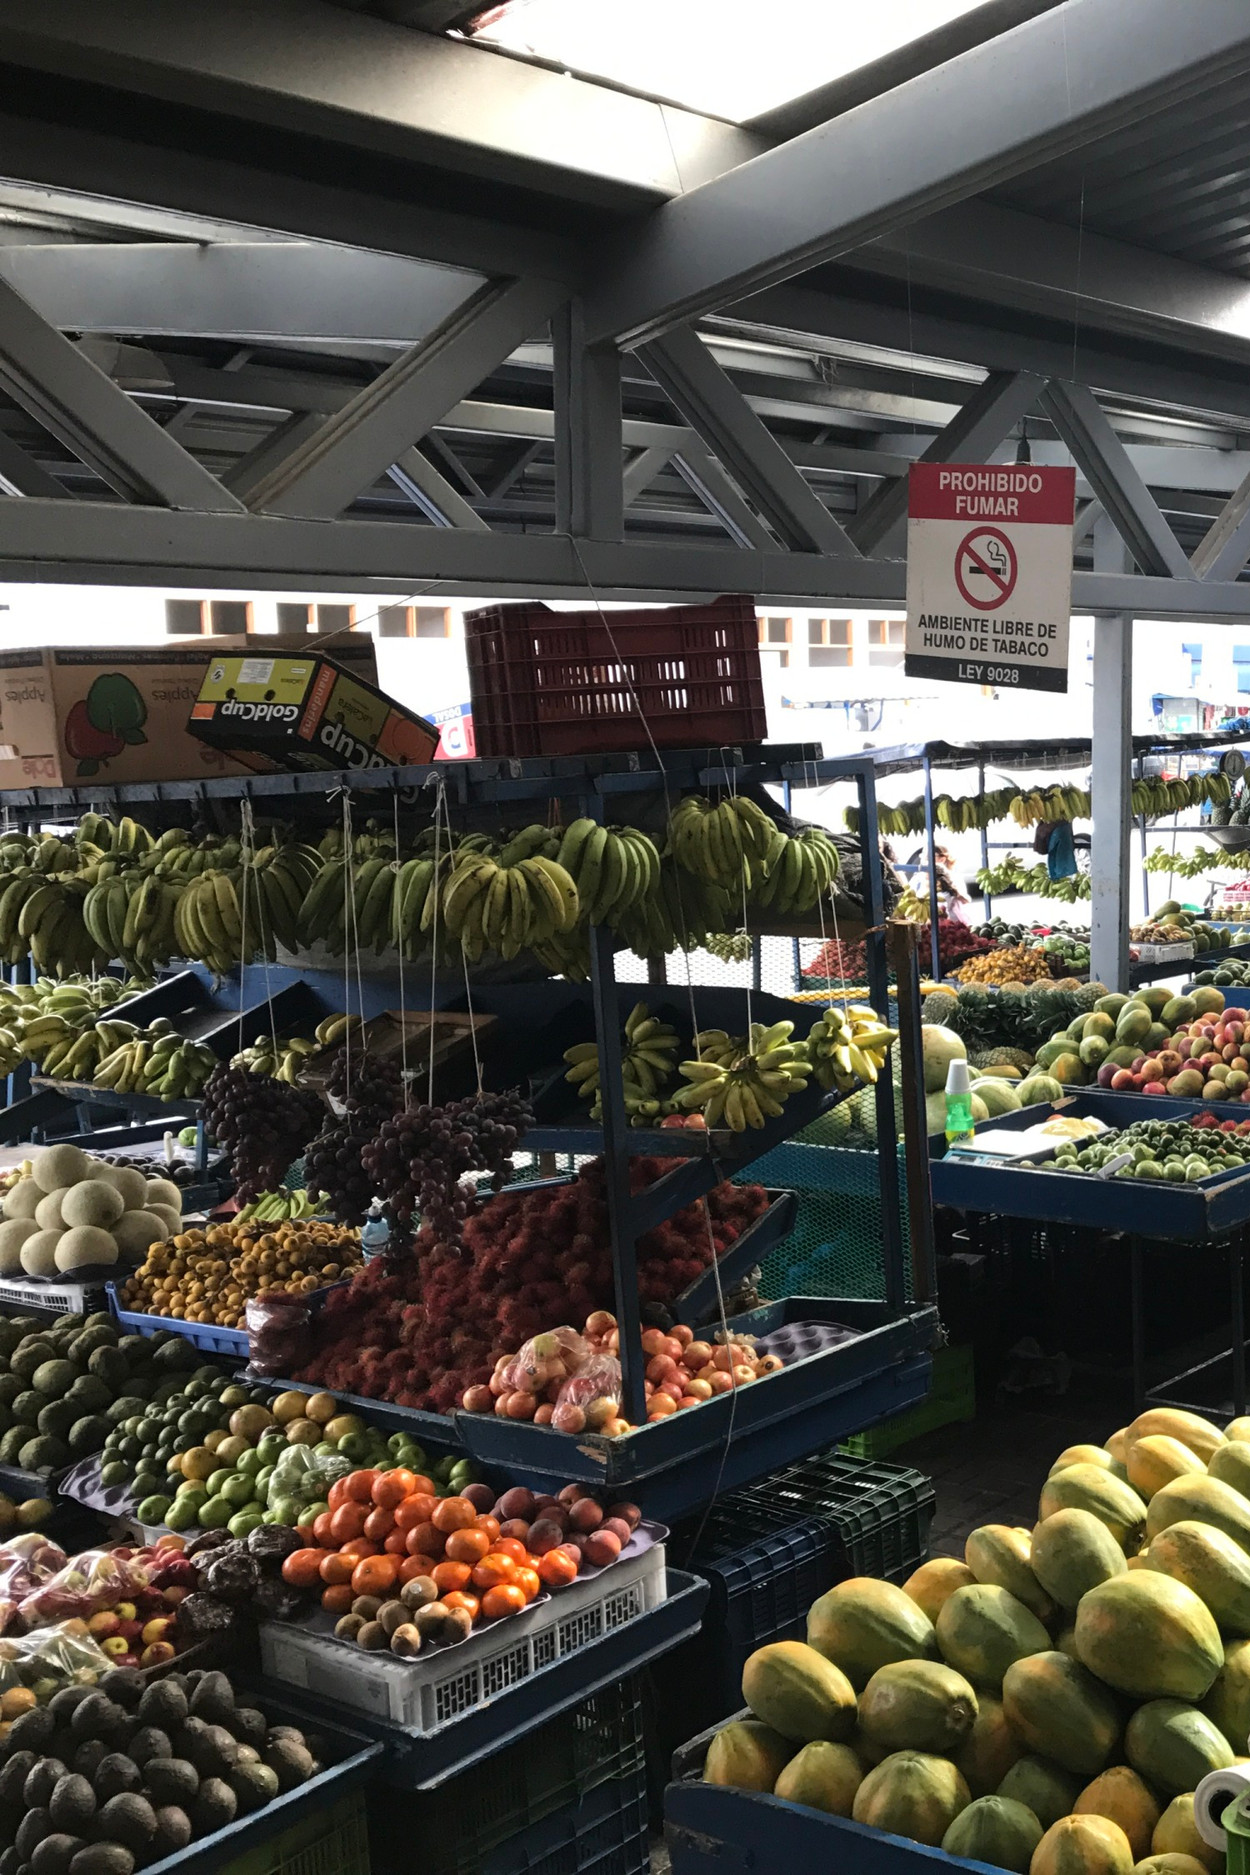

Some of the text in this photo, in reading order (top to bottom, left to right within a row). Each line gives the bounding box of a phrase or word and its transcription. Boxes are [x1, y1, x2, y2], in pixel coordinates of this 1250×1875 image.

[939, 472, 1043, 493] PROHIBIDO
[956, 496, 1019, 516] FUMAR
[918, 614, 1057, 639] AMBIENTE LIBRE DE
[923, 633, 1049, 657] HUMO DE TABACO
[958, 664, 1019, 684] LEY 9028
[5, 686, 46, 704] Apples
[221, 699, 299, 721] GoldCup
[22, 758, 57, 779] Dole
